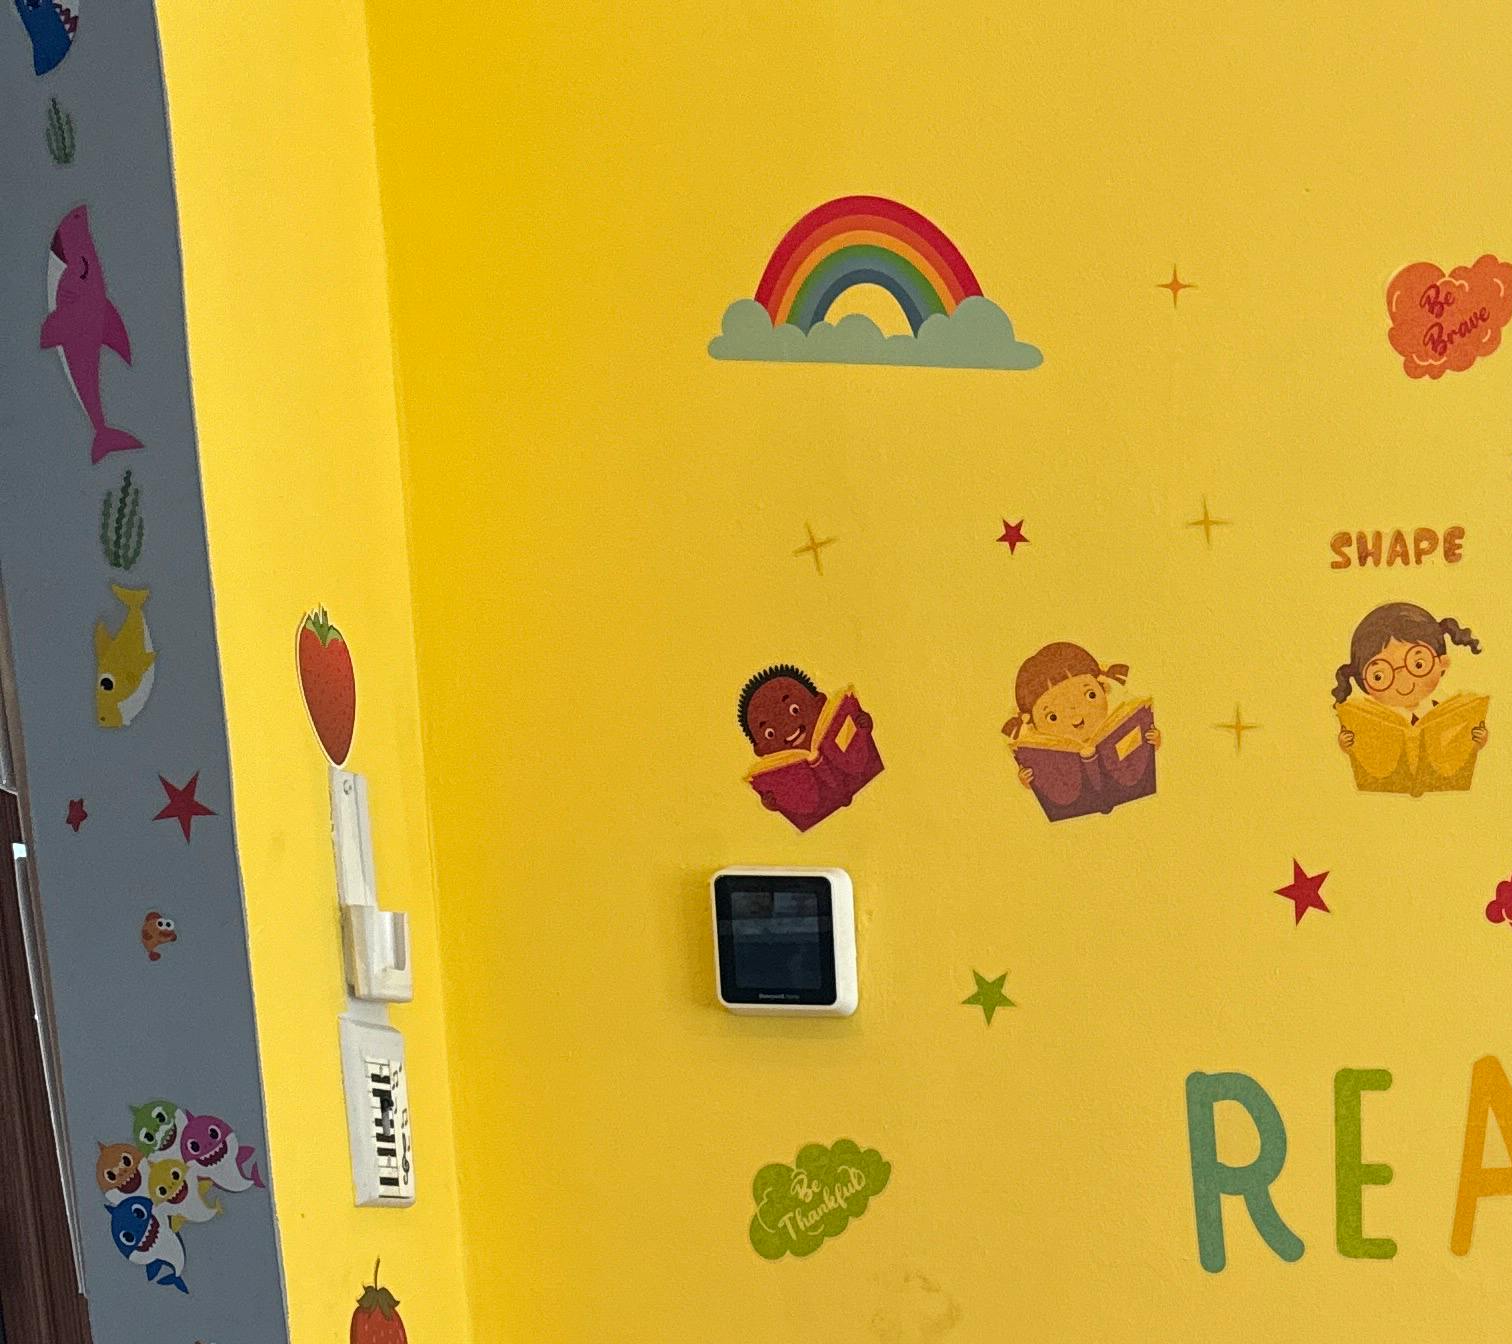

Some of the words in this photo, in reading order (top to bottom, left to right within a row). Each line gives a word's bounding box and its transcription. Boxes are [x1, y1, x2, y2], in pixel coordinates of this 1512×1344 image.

[1419, 283, 1455, 318] Be
[1423, 307, 1490, 356] Brave
[1330, 526, 1465, 569] SHAPE
[778, 1166, 866, 1240] Thankful
[790, 1173, 821, 1203] Be
